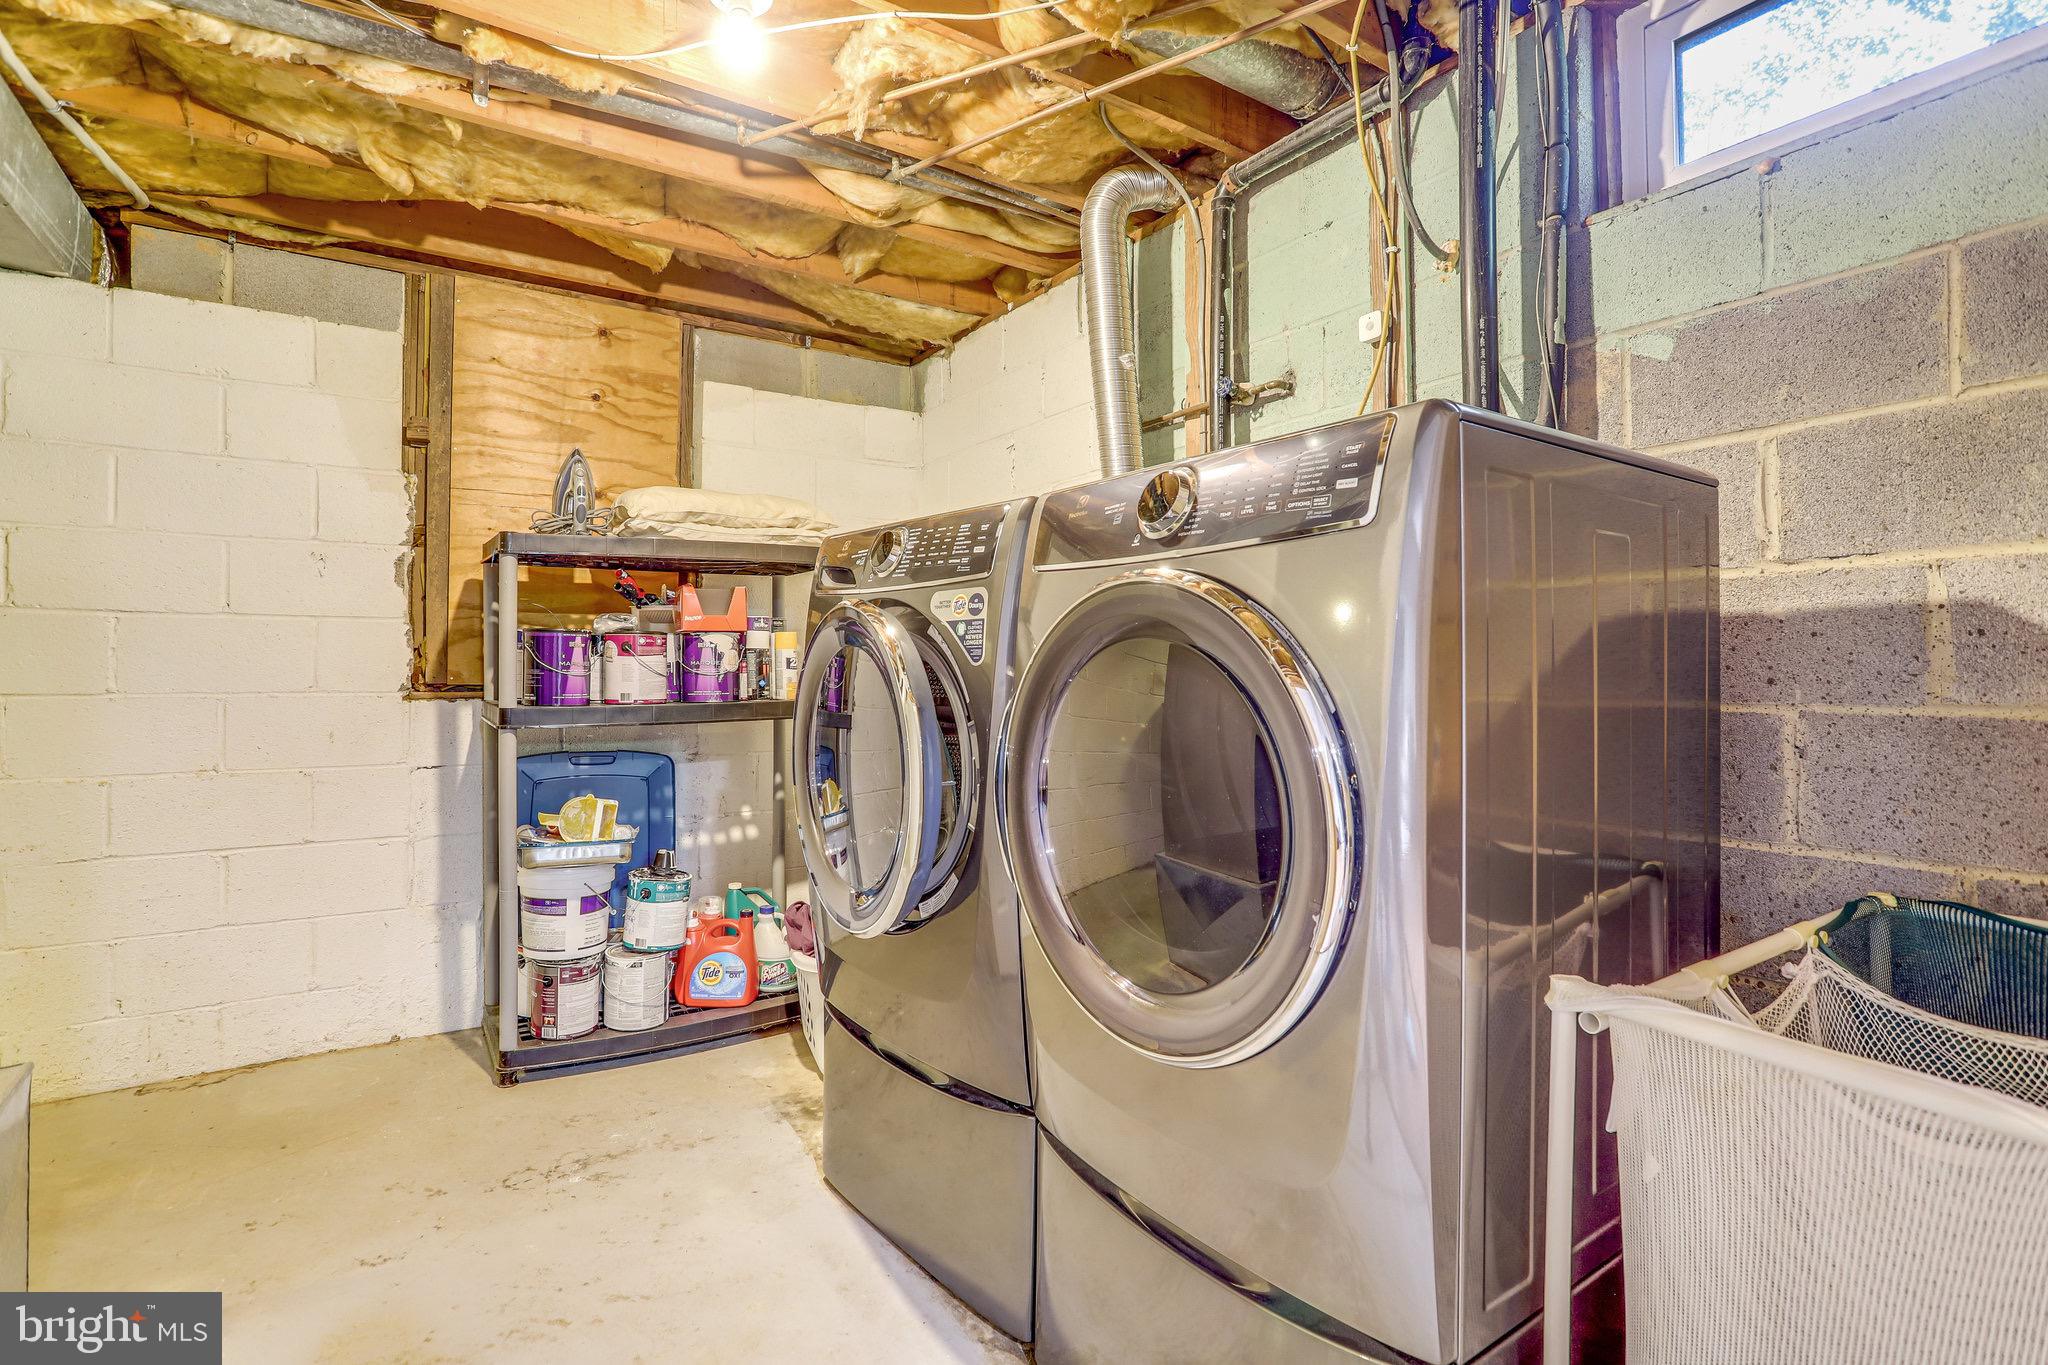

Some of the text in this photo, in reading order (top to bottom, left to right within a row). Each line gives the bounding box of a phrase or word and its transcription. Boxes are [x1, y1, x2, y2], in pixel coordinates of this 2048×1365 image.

[1346, 443, 1362, 451] START
[1287, 500, 1311, 508] OPTIONS
[953, 600, 967, 613] Tide
[702, 966, 721, 981] Tide
